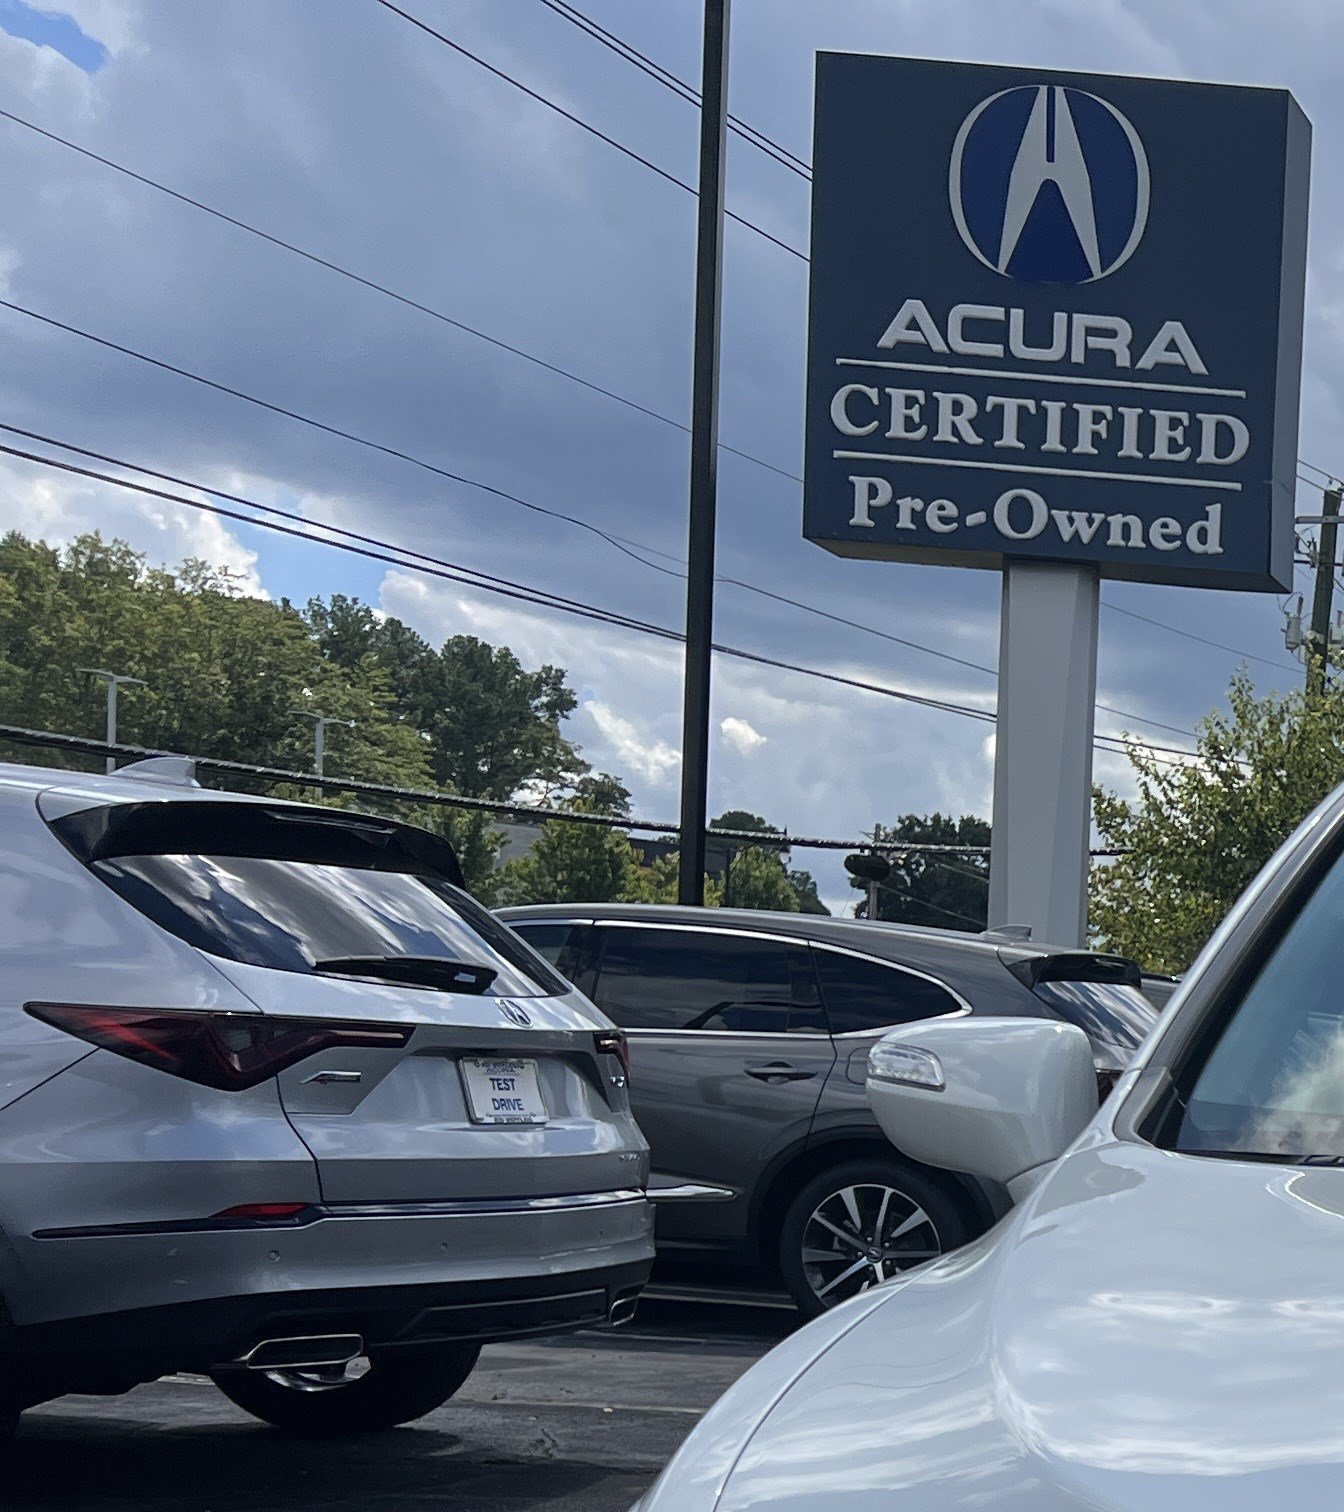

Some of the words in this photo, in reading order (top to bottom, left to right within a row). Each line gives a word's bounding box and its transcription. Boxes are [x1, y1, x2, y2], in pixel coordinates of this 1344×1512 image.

[876, 298, 1210, 376] ACURA
[829, 383, 1251, 466] CERTIFIED
[847, 475, 1225, 556] Pre-Owned
[489, 1077, 516, 1092] TEST
[491, 1097, 525, 1111] DRIVE
